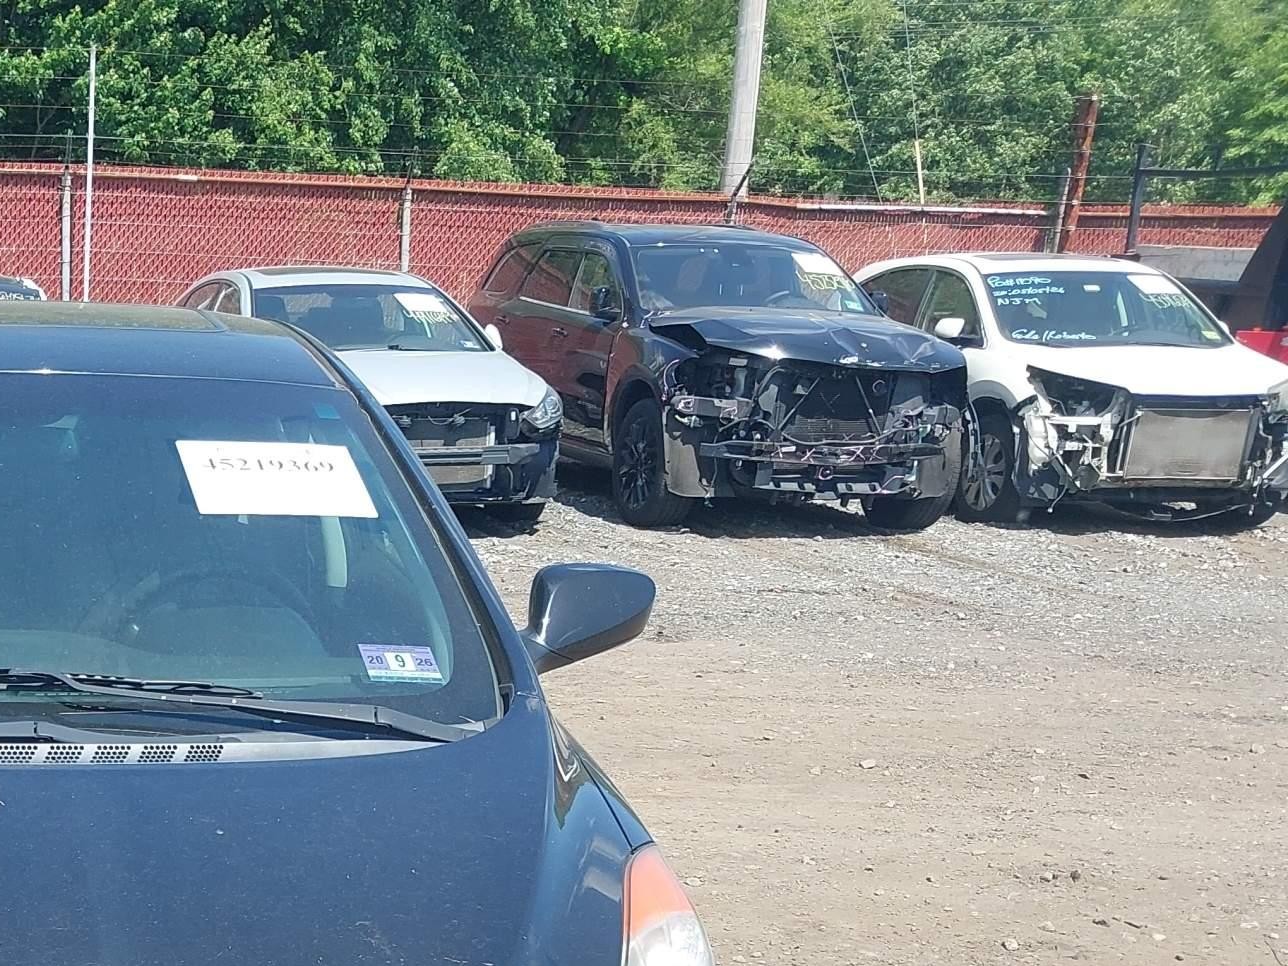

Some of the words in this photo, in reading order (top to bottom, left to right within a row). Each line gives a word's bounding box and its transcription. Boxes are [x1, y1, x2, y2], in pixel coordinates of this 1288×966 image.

[367, 655, 384, 665] 20
[394, 654, 406, 668] 9
[415, 658, 433, 667] 26
